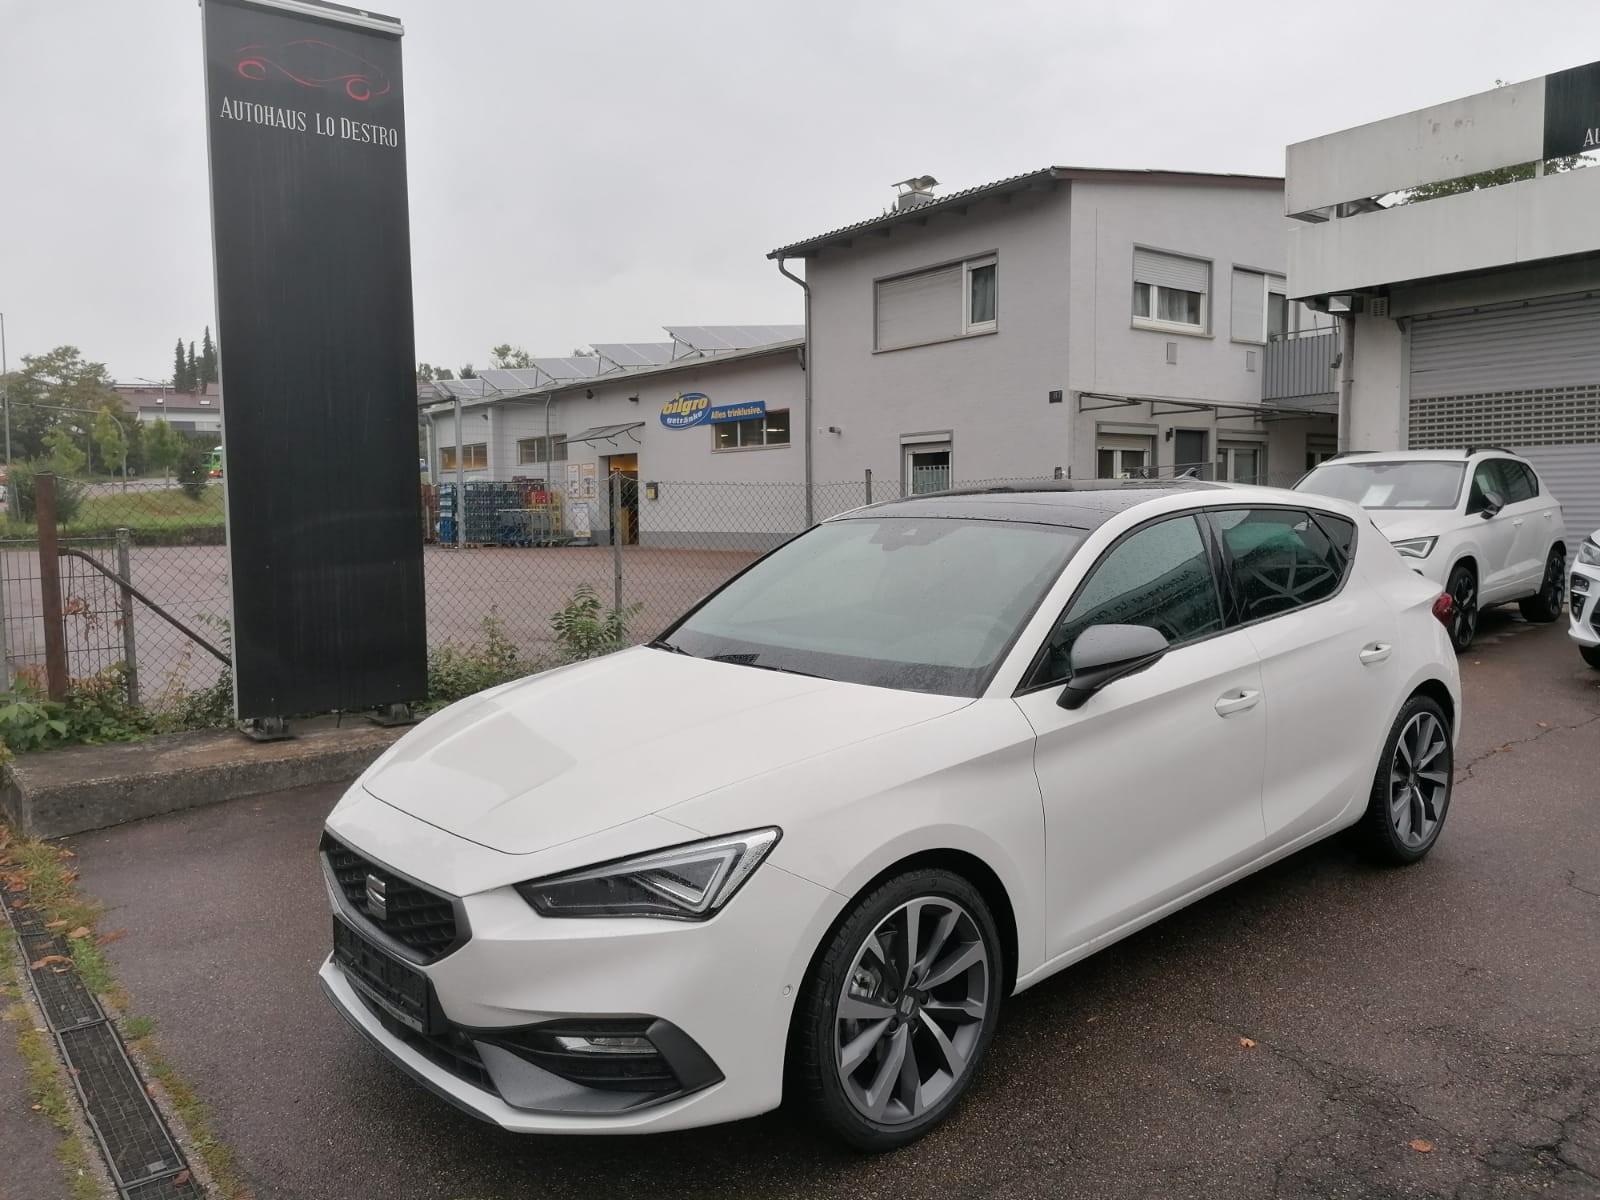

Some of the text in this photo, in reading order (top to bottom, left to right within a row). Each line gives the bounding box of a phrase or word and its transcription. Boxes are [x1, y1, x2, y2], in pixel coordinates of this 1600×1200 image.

[220, 96, 398, 148] AUTOHAUS LO DESTRO
[662, 392, 708, 416] bilgro
